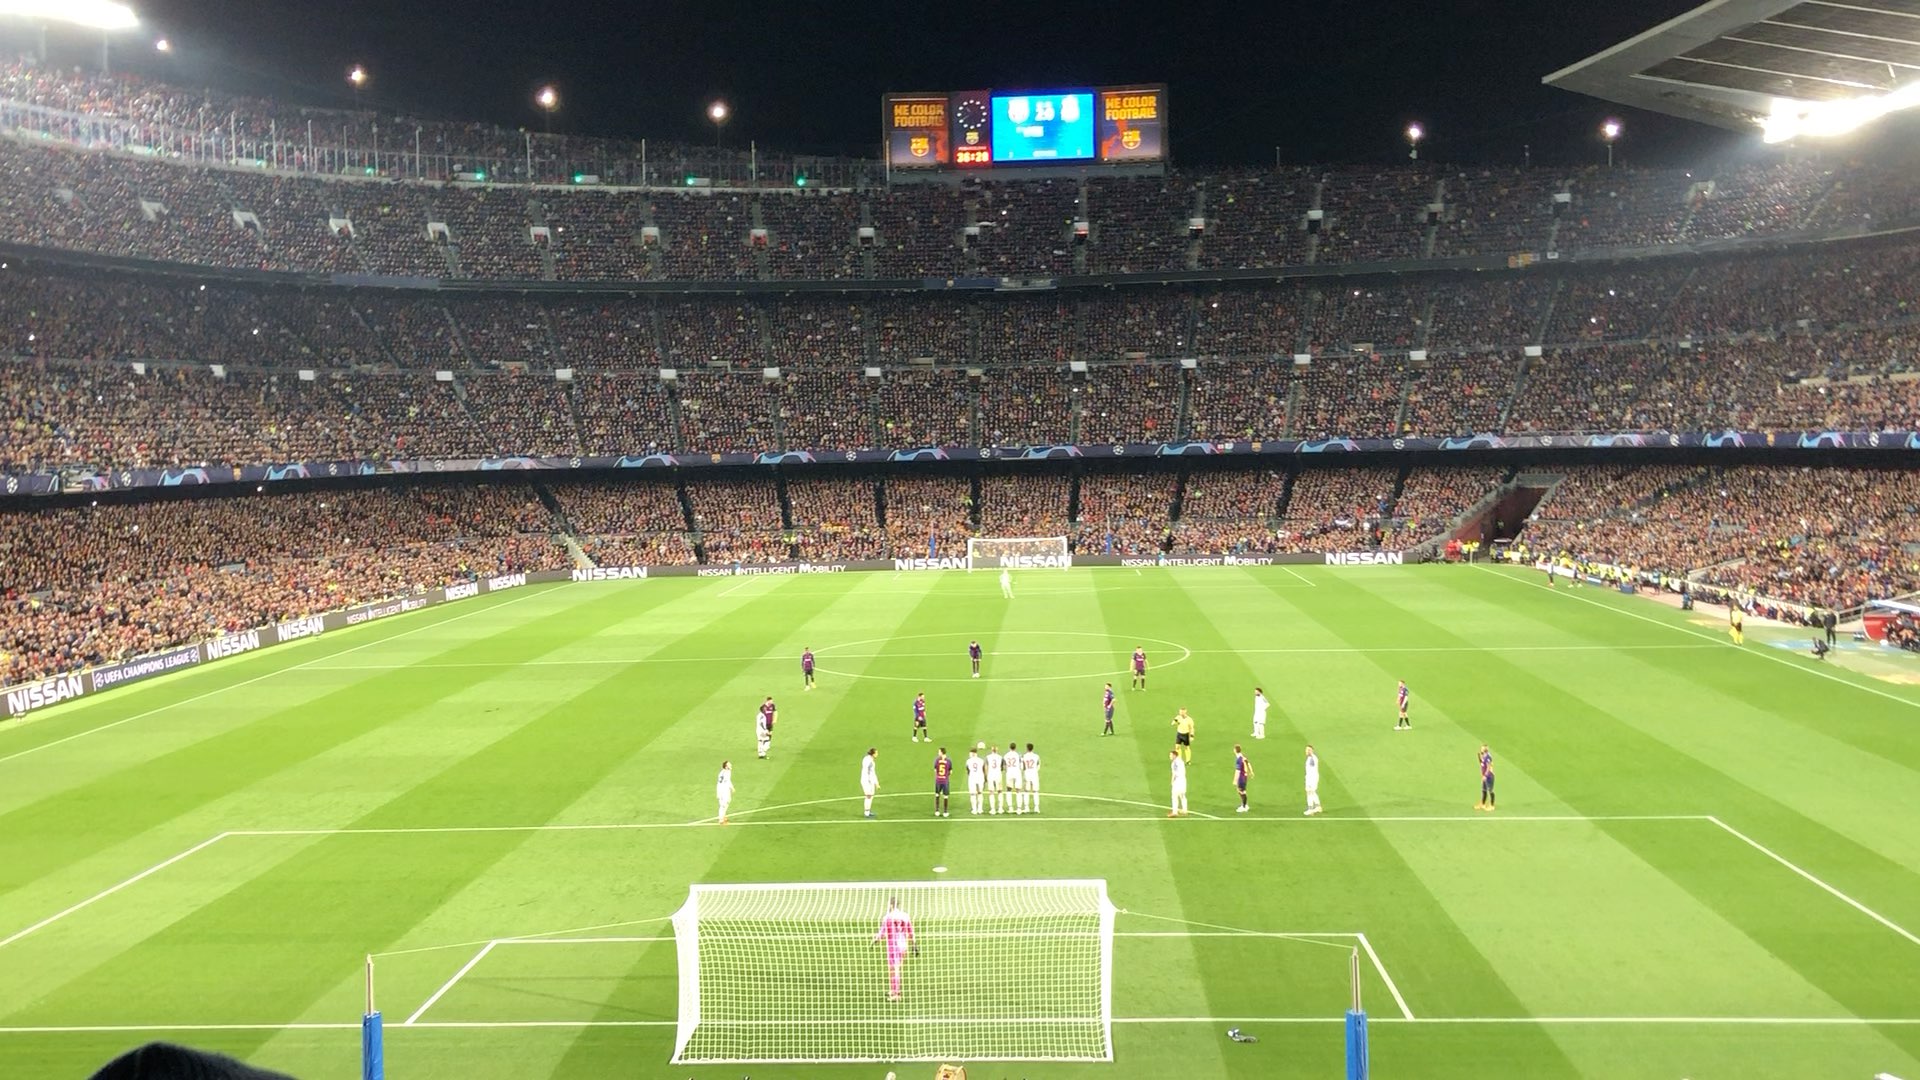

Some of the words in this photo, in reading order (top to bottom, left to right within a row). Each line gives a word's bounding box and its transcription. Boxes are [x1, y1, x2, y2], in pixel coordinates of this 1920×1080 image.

[1123, 96, 1156, 108] COLOR
[895, 558, 967, 570] NISSAN
[1000, 555, 1072, 568] NISSAN
[1121, 558, 1156, 566] NISSAN
[1158, 557, 1222, 566] INTELLIGENT
[1224, 555, 1273, 566] MOBILITY
[1325, 552, 1402, 565] NISSAN
[571, 566, 648, 581] NISSAN
[697, 568, 732, 577] NISSAN
[735, 565, 797, 576] INTELLIGENT
[799, 563, 846, 574] MOBILITY
[488, 573, 526, 592] NISSAN
[445, 583, 479, 601] NISSAN
[347, 612, 367, 625] NISSAN
[277, 617, 324, 642] NISSAN
[207, 631, 260, 660] NISSAN
[104, 670, 122, 683] UEFA
[123, 658, 164, 680] CHAMPIONS
[165, 652, 190, 669] LEAGUE
[8, 675, 83, 714] NISSAN
[938, 764, 946, 776] 5
[973, 763, 979, 773] 9
